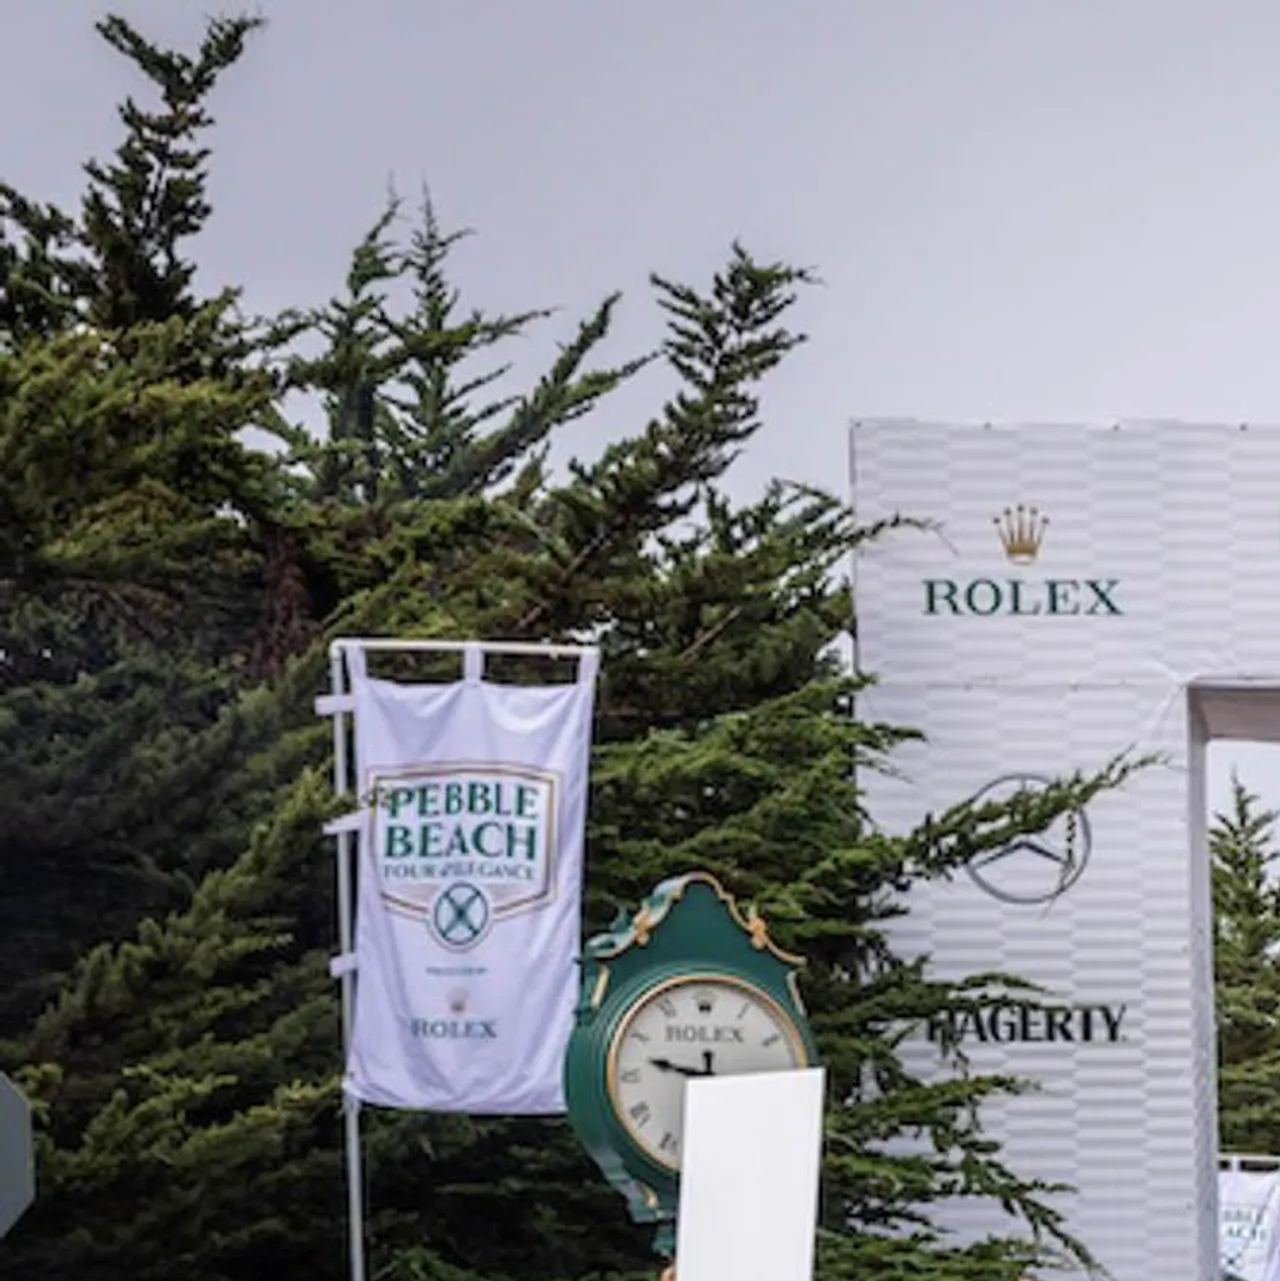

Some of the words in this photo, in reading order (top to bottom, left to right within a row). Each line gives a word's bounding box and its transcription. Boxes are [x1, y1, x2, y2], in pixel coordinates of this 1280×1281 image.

[922, 579, 1123, 616] ROLEX
[387, 780, 540, 820] PEBBLE
[384, 822, 537, 861] BEACH
[409, 1018, 498, 1039] ROLEX
[665, 1025, 745, 1043] ROLEX
